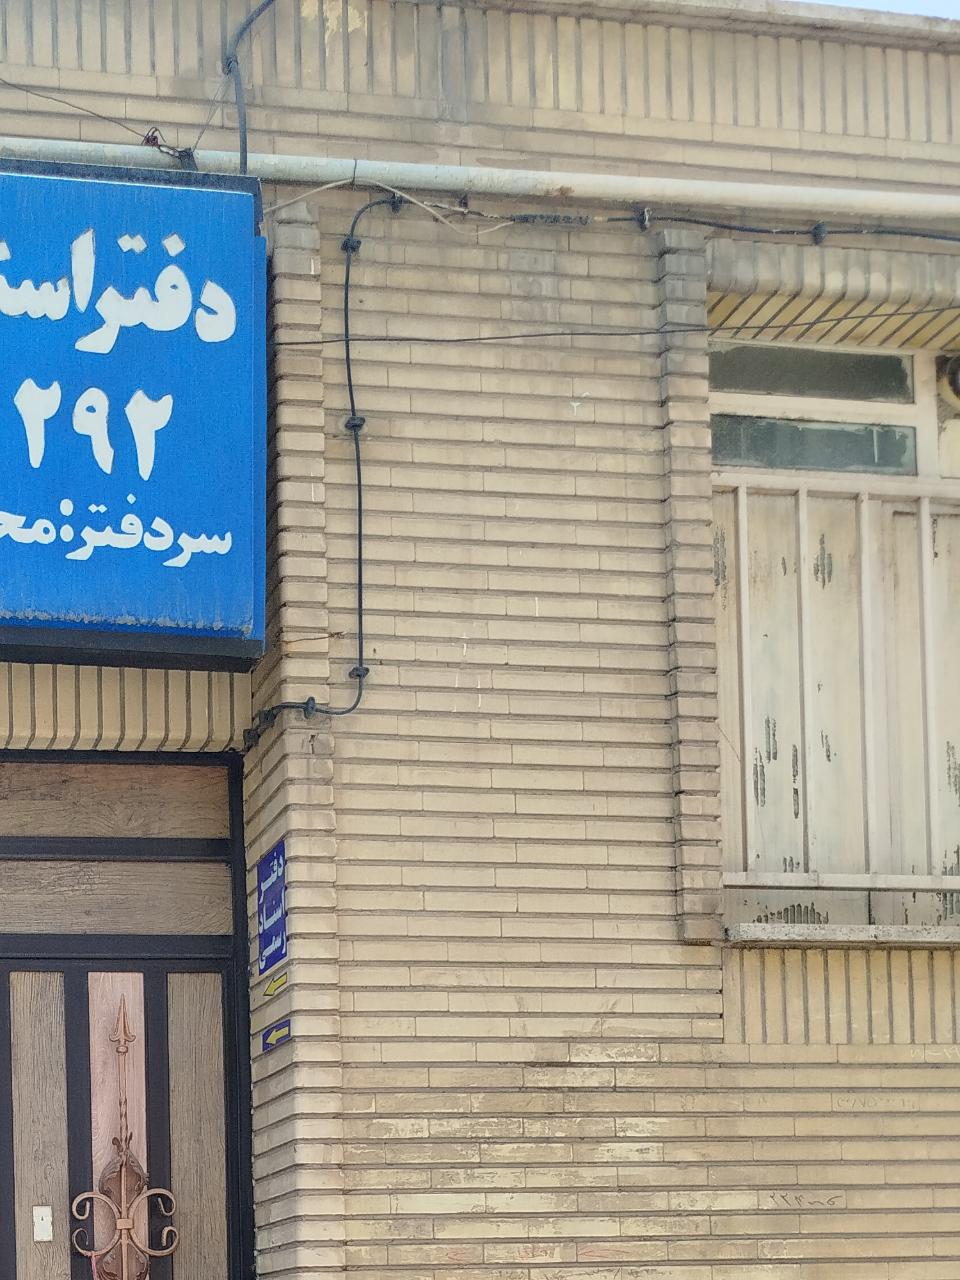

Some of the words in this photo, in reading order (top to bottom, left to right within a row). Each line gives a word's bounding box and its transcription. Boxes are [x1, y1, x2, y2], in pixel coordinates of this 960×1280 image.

[73, 232, 238, 355] دفتر
[12, 377, 175, 482] ۲۹۲
[259, 851, 284, 905] دفتر
[259, 887, 286, 935] اسناد
[259, 930, 287, 970] رسمی
